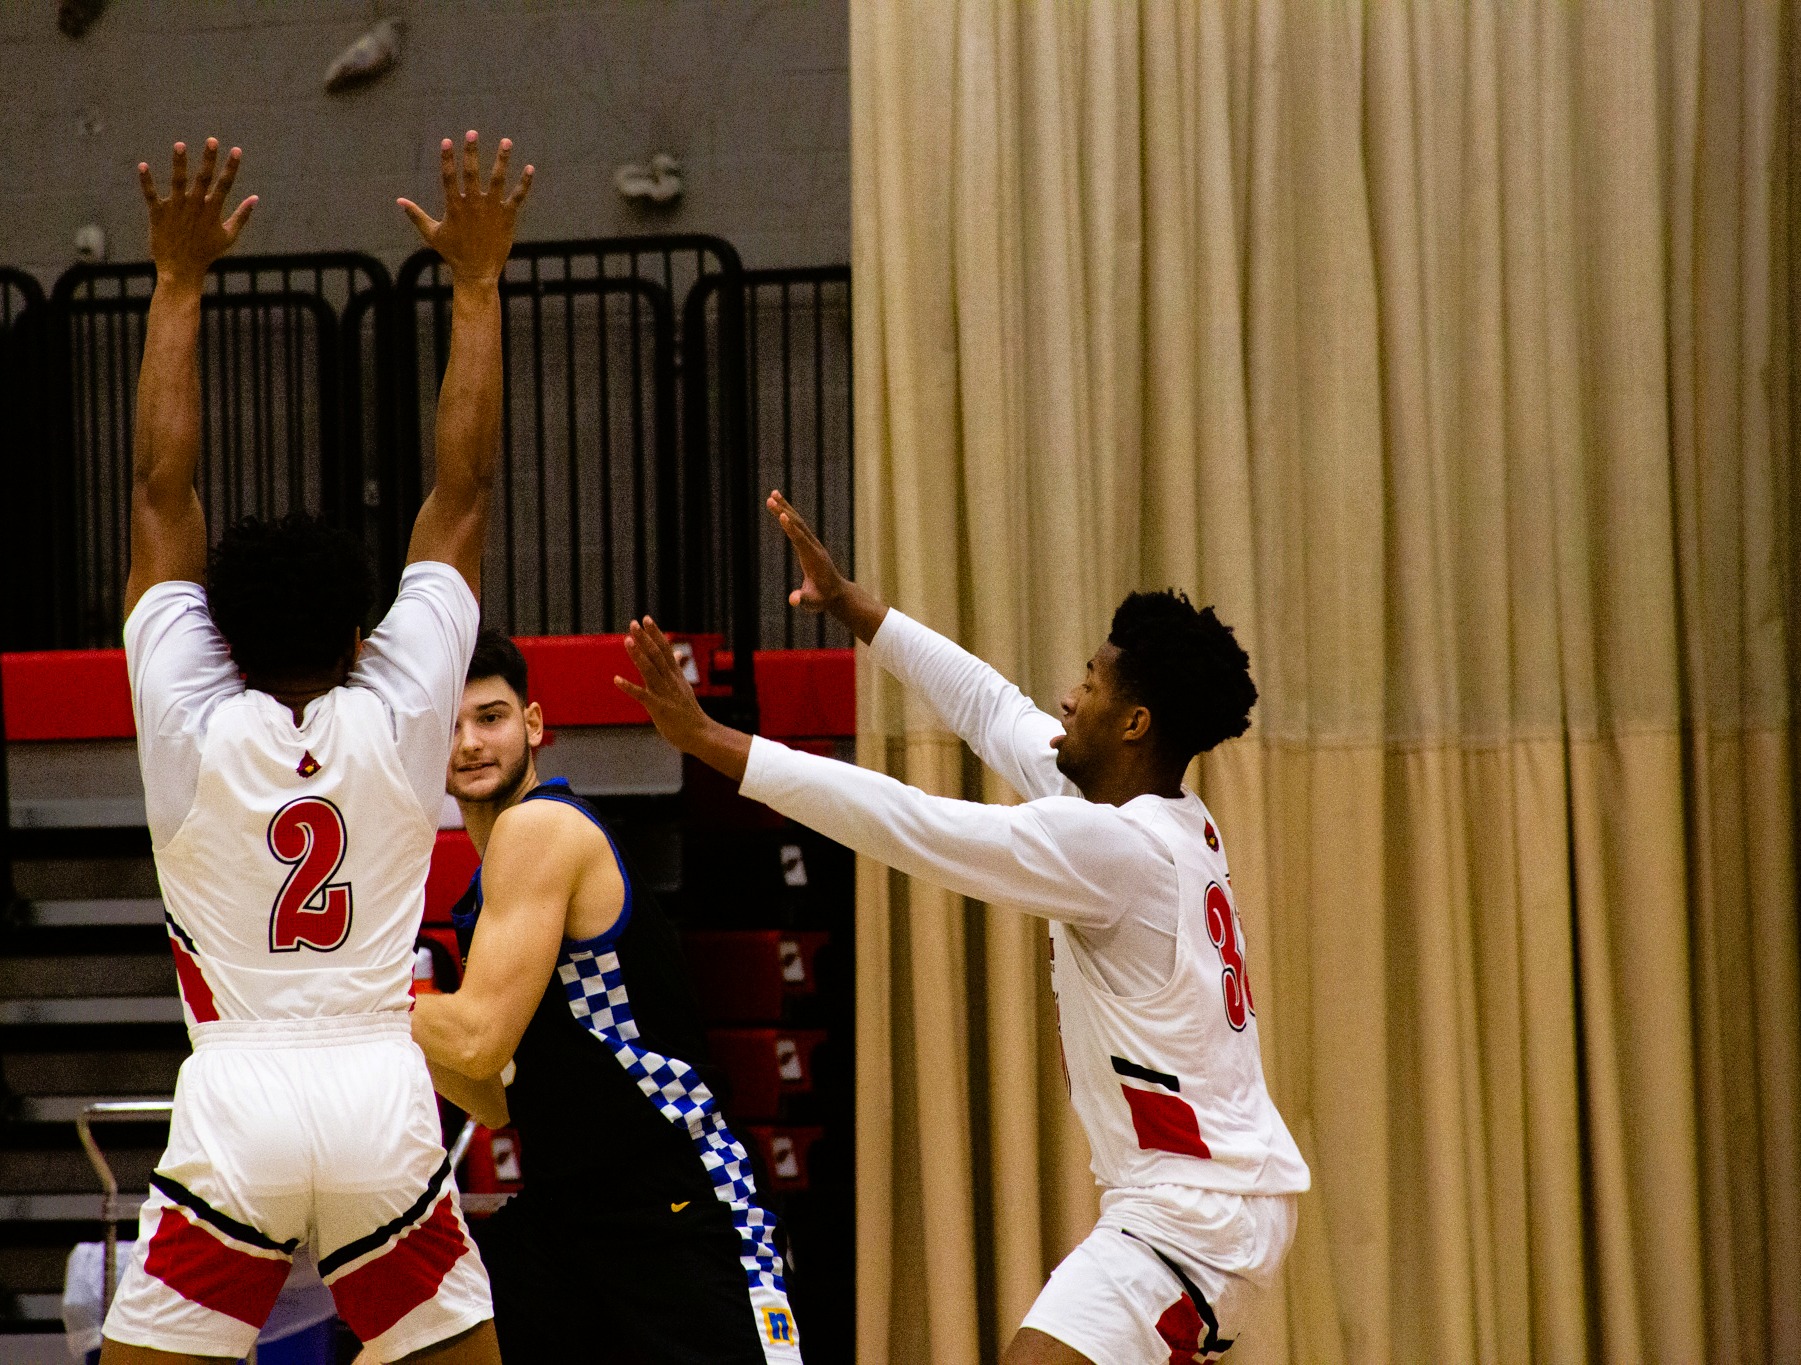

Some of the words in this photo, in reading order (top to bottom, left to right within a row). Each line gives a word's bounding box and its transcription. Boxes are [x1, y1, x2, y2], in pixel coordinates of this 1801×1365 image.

[267, 795, 353, 953] 2
[1204, 873, 1256, 1033] 3
[767, 1311, 790, 1341] n
